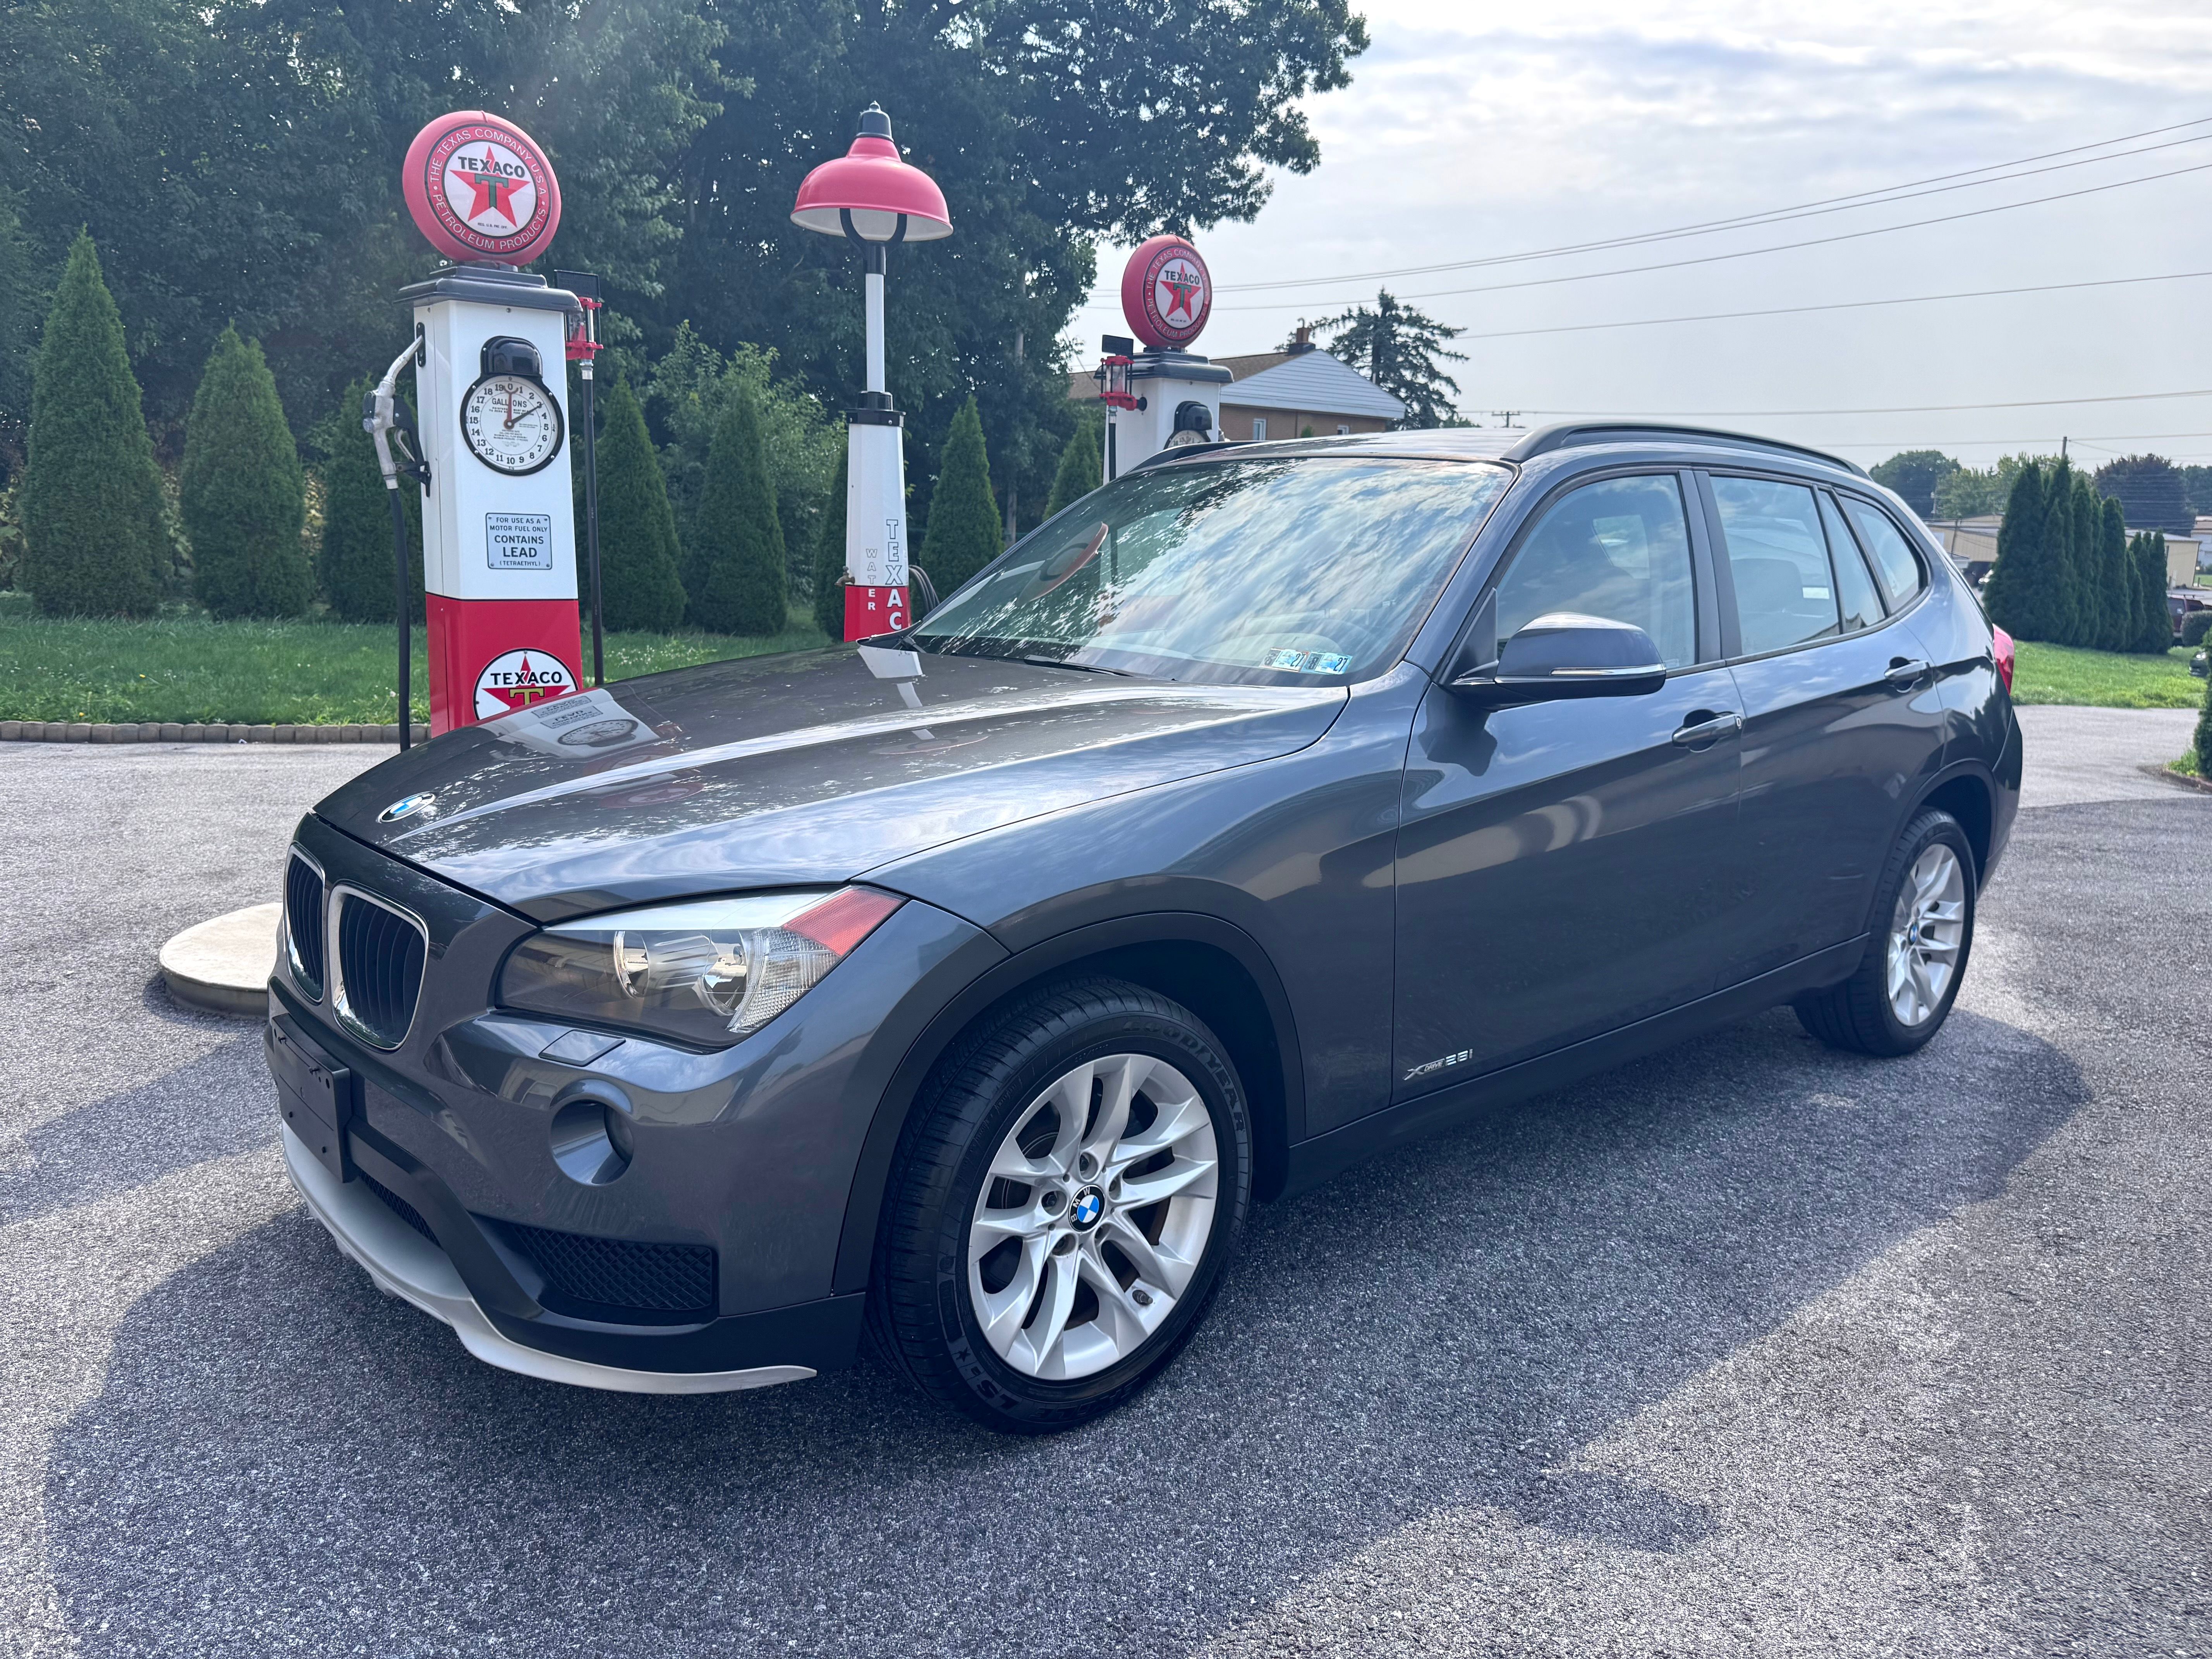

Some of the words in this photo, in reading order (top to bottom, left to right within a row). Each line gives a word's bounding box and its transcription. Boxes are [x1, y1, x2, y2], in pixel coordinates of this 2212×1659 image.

[430, 158, 443, 183] THE
[437, 130, 471, 156] TEXAS
[475, 129, 532, 160] COMPANY
[458, 156, 525, 178] TEXACO
[433, 193, 495, 249] PETROLEUM
[500, 209, 546, 249] PRODUCTS
[1147, 272, 1156, 289] THE
[1153, 251, 1173, 270] TEXAS
[1164, 270, 1200, 285] TEXACO
[492, 398, 527, 408] GALLONS
[495, 535, 544, 544] CONTAINS
[503, 547, 537, 558] LEAD
[866, 548, 878, 610] WATER
[885, 519, 903, 630] TEXAC
[490, 671, 562, 685] TEXACO
[1333, 657, 1349, 673] 27
[1121, 1020, 1247, 1132] GOODYEAR
[1071, 1187, 1090, 1223] BMW
